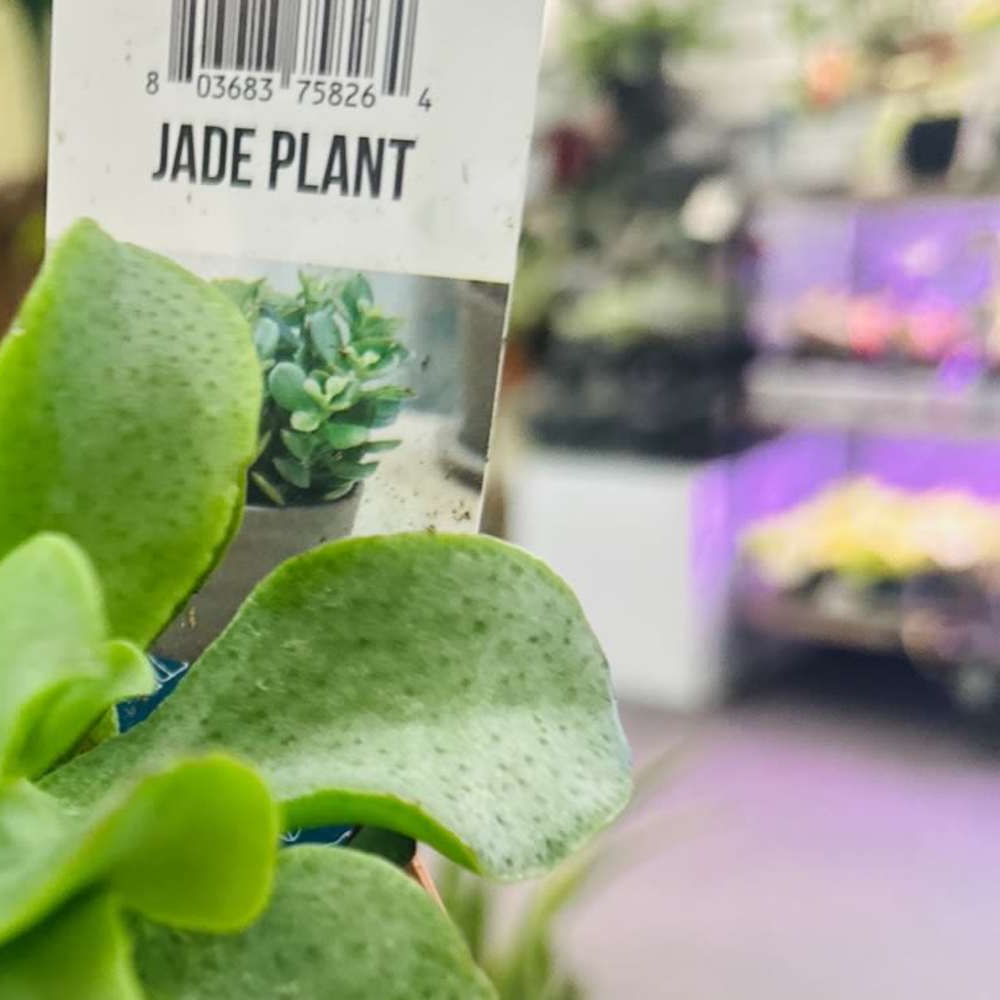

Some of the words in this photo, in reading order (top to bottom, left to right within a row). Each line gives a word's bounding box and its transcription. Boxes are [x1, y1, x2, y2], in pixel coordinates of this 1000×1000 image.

[145, 71, 160, 95] 8
[196, 74, 273, 102] 03683
[296, 80, 376, 109] 75826
[417, 87, 433, 112] 4
[151, 122, 256, 188] JADE
[268, 129, 416, 201] PLANT
